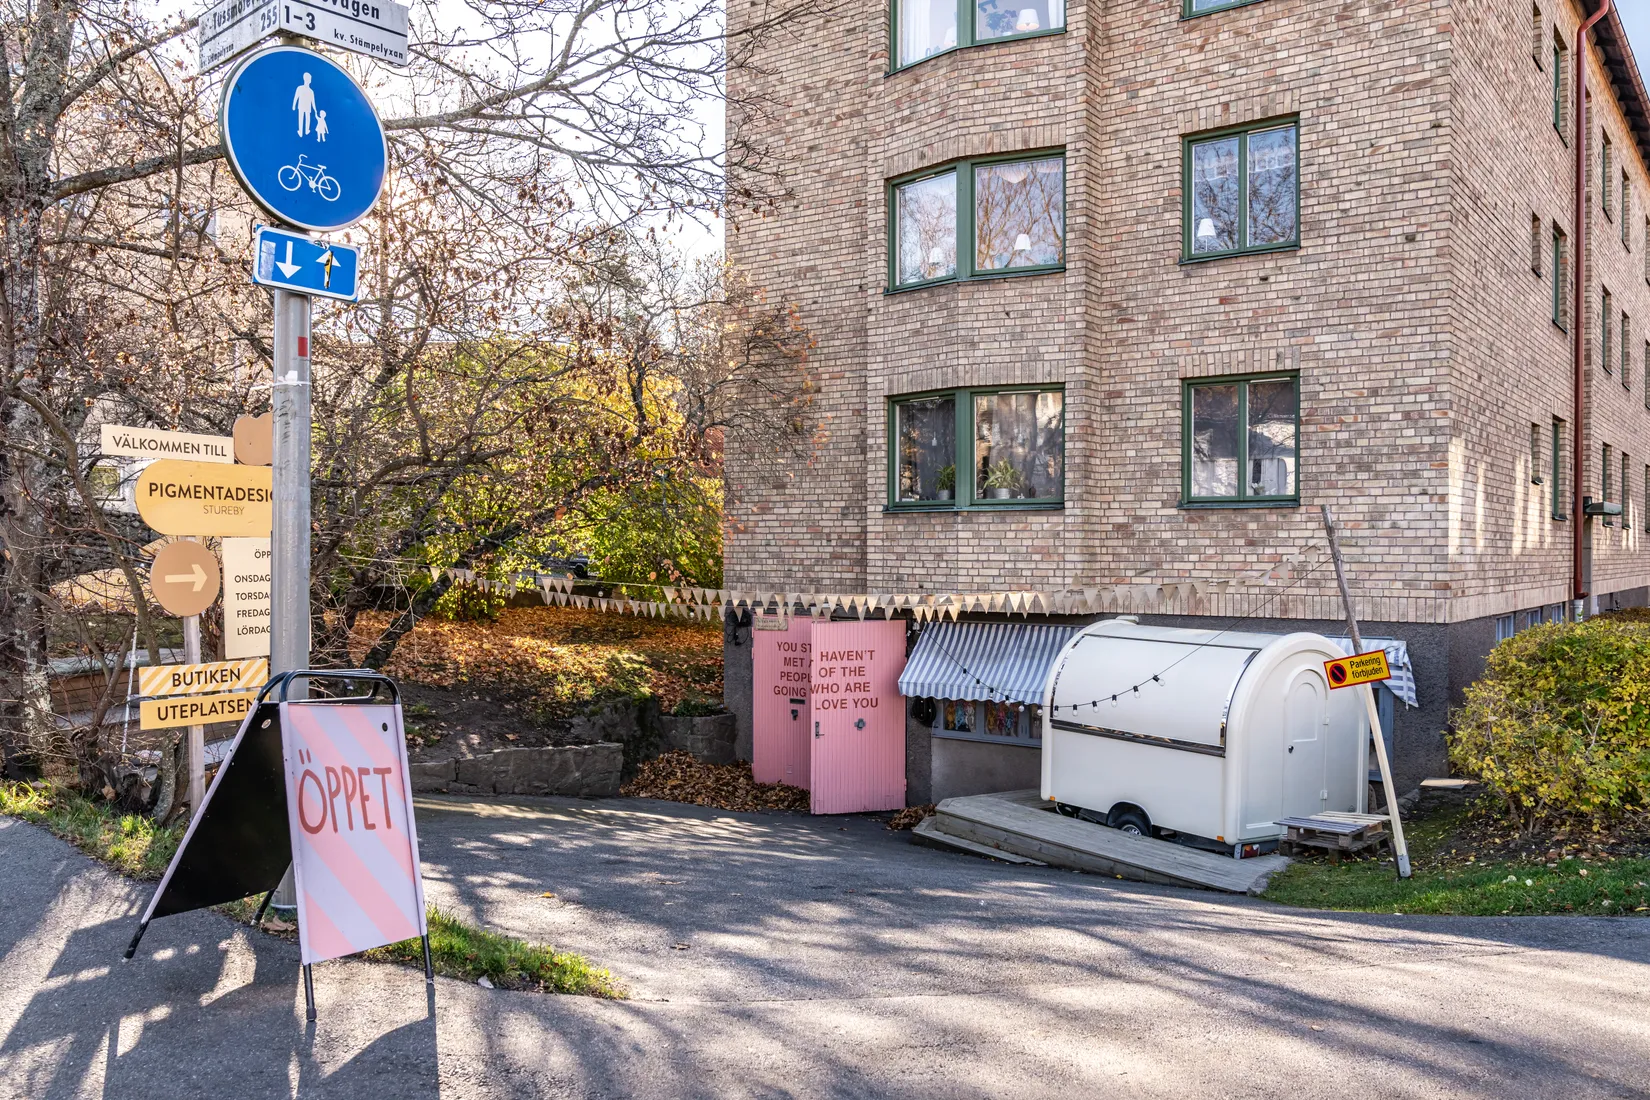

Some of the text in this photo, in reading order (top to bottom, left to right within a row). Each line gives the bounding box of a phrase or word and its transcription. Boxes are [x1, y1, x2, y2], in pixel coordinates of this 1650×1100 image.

[261, 5, 278, 32] 255
[334, 28, 404, 59] kv. Stämpelyxan
[112, 433, 227, 457] VÄLKOMMEN TILL
[203, 505, 245, 516] STUREBY
[254, 548, 271, 559] ÖPP
[234, 574, 271, 583] ONSDAG
[236, 592, 271, 601] TORSDA
[237, 609, 271, 618] FREDAG
[777, 642, 798, 652] YOU
[820, 650, 875, 662] HAVEN'T
[783, 657, 805, 668] MET
[1350, 657, 1381, 669] Parkering
[172, 668, 241, 688] BUTIKEN
[780, 671, 812, 683] PEOPL
[819, 666, 866, 678] OF THE
[1352, 666, 1383, 678] förbjuden
[773, 685, 807, 697] GOING
[811, 682, 871, 694] WHO ARE
[157, 698, 256, 721] UTEPLATSEN
[815, 697, 879, 710] LOVE YOU
[298, 748, 392, 834] ÖPPET
